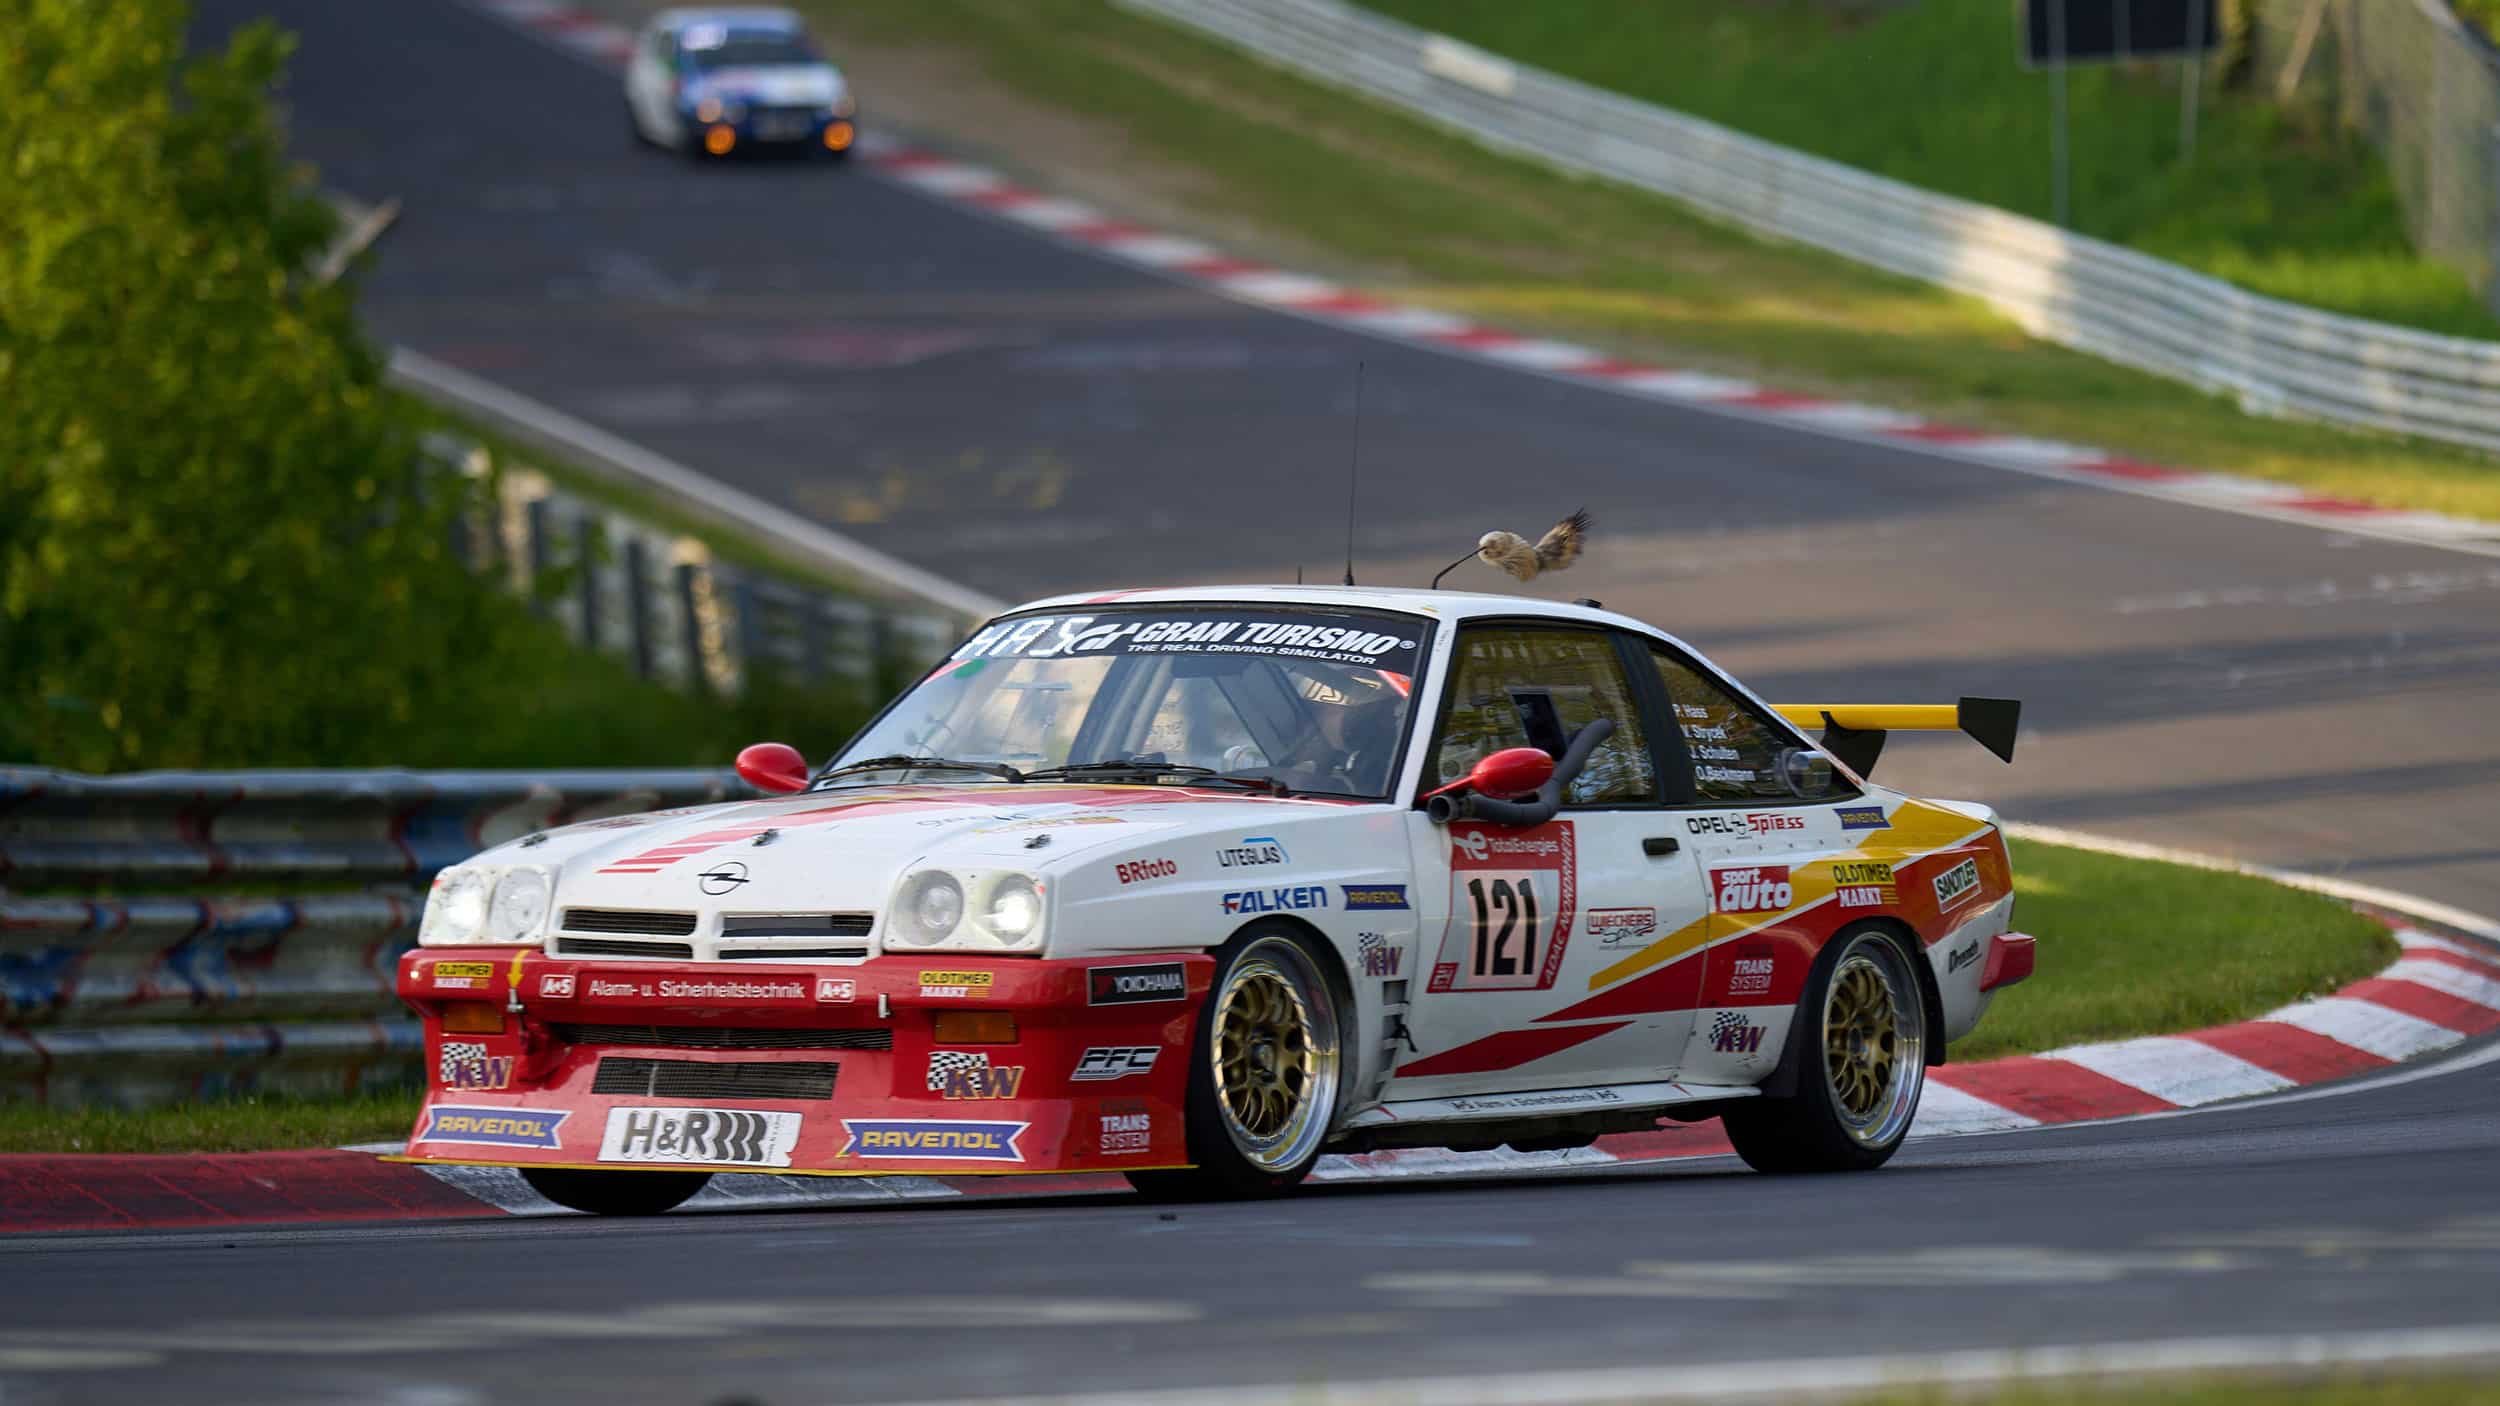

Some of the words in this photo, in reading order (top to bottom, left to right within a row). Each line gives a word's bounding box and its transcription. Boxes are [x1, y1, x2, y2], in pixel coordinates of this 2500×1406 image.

[1133, 622, 1242, 643] GRAN
[1127, 644, 1162, 653] THE
[1164, 644, 1202, 653] REAL
[1206, 644, 1274, 655] DRIVING
[1276, 647, 1376, 665] SIMULATOR
[1687, 817, 1733, 835] OPEL
[1746, 813, 1804, 835] Spiess
[1216, 846, 1281, 867] LITEGLAS
[1116, 857, 1177, 884] BRfoto
[1721, 868, 1760, 886] sport
[1833, 864, 1893, 883] OLDTIMER
[1221, 886, 1328, 914] FALKEN
[1349, 892, 1403, 904] RAVENOL
[1544, 936, 1566, 985] ADAC
[1559, 824, 1573, 934] NORDRHEIN
[1720, 879, 1792, 911] auto
[1838, 887, 1882, 907] MARKT
[1468, 879, 1537, 976] 121
[1590, 914, 1651, 927] WIECHERS
[1365, 946, 1403, 976] KW
[1734, 959, 1773, 975] TRANS
[588, 980, 638, 996] Alarm-
[641, 984, 655, 997] u.
[659, 980, 805, 999] Sicherheitstechnik
[820, 982, 852, 998] A+S
[922, 973, 991, 985] OLDTIMER
[1114, 973, 1183, 993] YOKOHAMA
[1729, 975, 1772, 990] SYSTEM
[1715, 1026, 1767, 1053] KW
[1077, 1047, 1160, 1069] PFC
[454, 1056, 513, 1089] KW
[943, 1066, 1025, 1100] KW
[437, 1116, 548, 1138] RAVENOL
[1101, 1115, 1150, 1132] TRANS
[622, 1111, 714, 1158] H&R
[861, 1131, 1002, 1149] RAVENOL
[1101, 1132, 1150, 1148] SYSTEM
